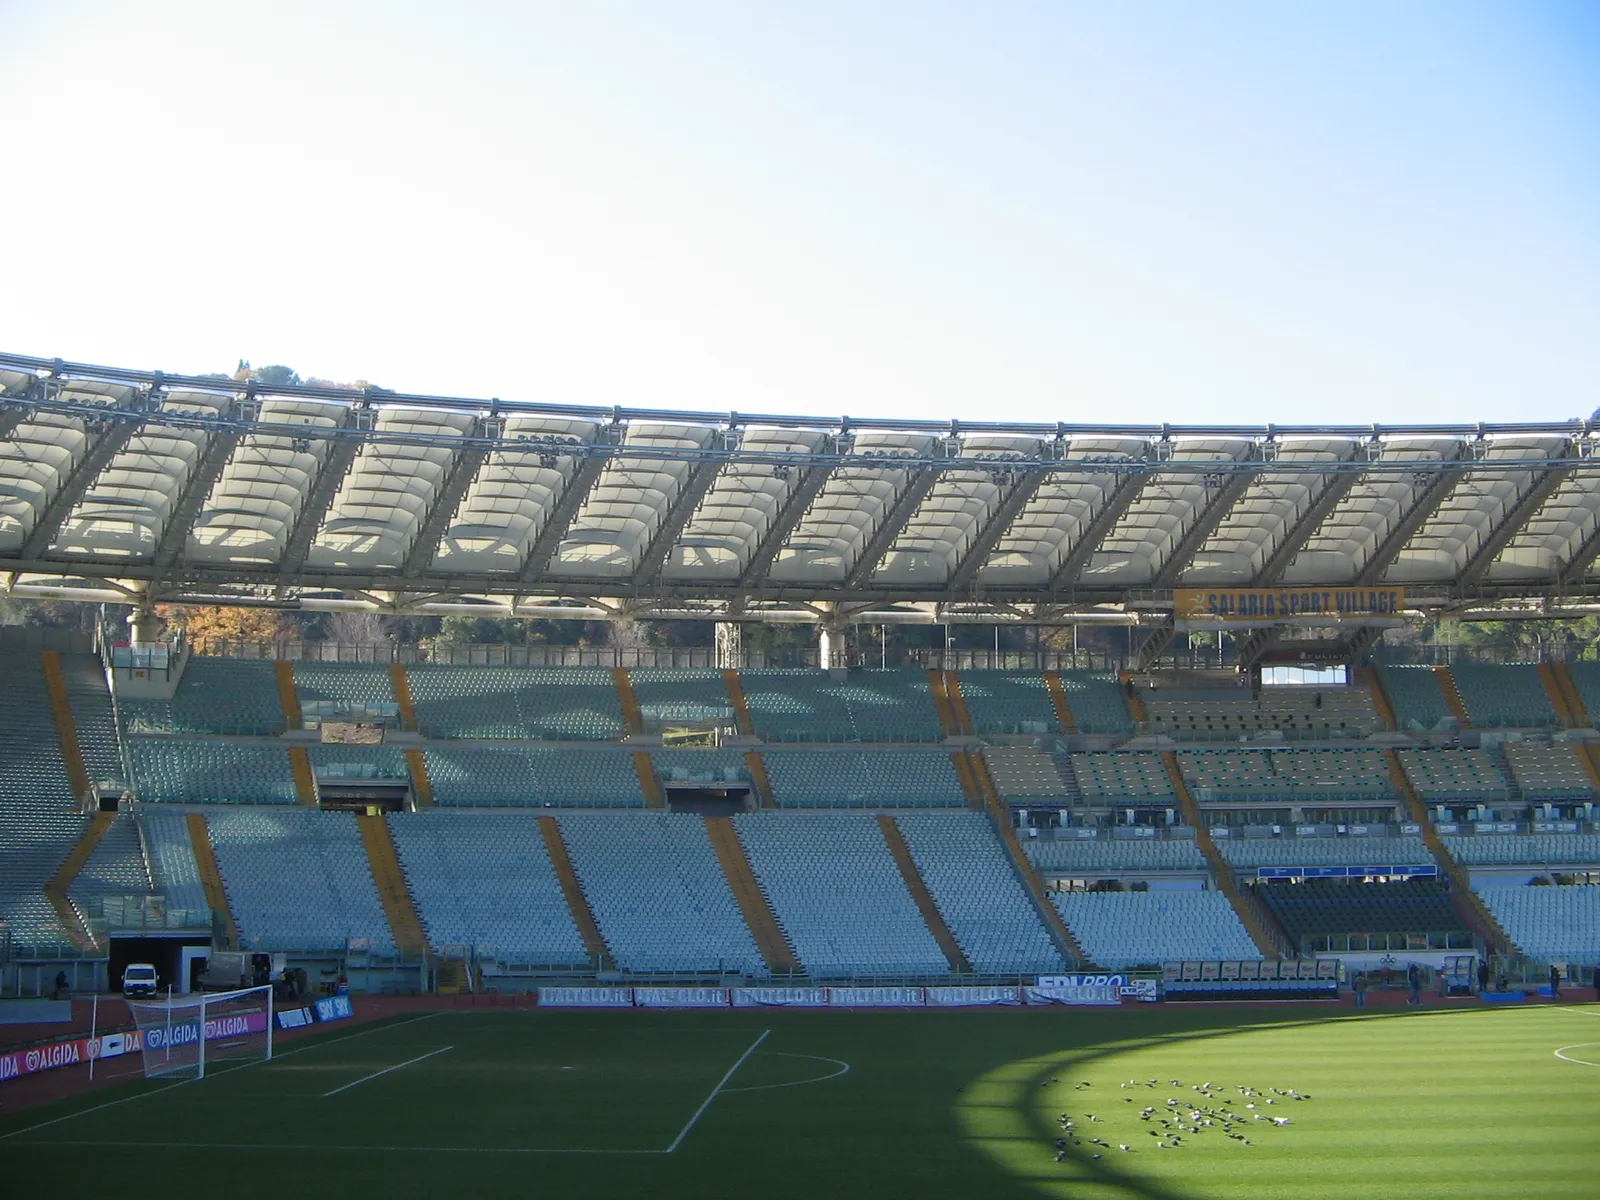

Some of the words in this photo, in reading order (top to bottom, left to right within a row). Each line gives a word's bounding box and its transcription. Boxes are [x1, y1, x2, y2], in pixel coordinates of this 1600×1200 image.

[1208, 593, 1275, 615] SALARIA
[1279, 592, 1330, 615] SPORT
[1335, 591, 1397, 613] VILLAGE
[162, 1025, 198, 1046] ALGIDA
[215, 1017, 249, 1038] ALGIDA
[40, 1043, 80, 1069] ALGIDA
